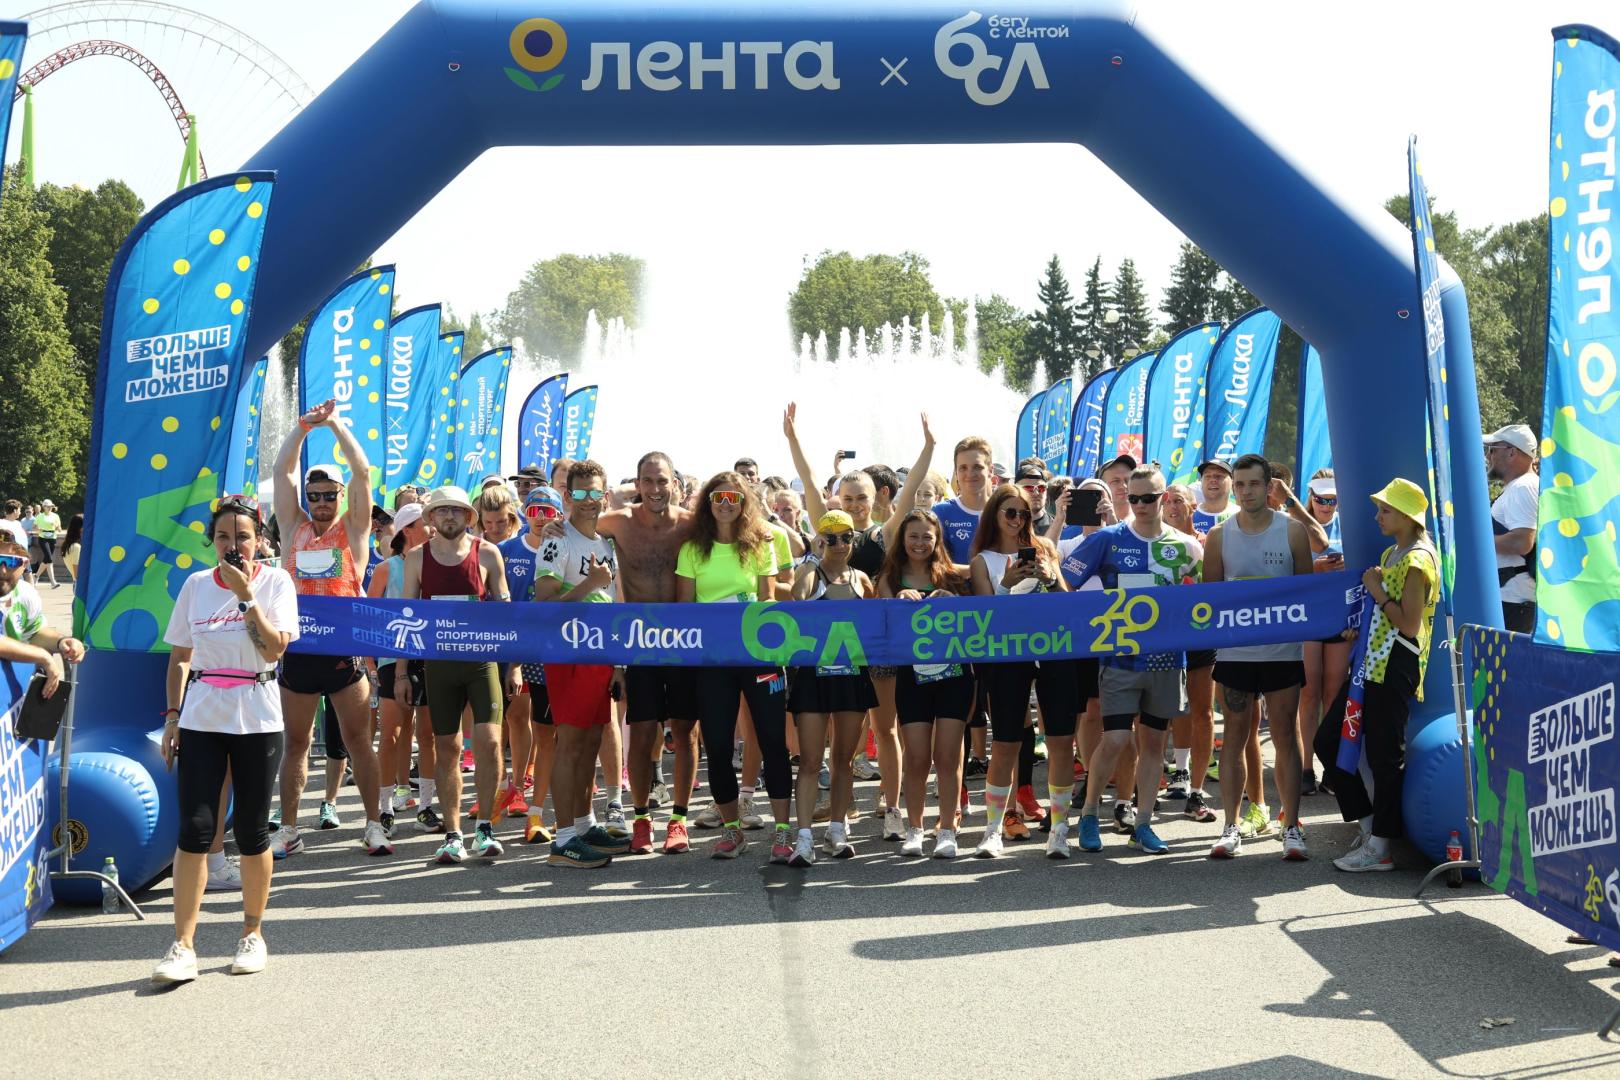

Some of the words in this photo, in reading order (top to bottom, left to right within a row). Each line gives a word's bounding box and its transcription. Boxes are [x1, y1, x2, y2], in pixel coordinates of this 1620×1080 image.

[988, 15, 1029, 29] бегу
[1006, 25, 1069, 38] лентой
[582, 41, 840, 91] лента
[129, 327, 229, 360] БОЛЬШЕ
[155, 352, 201, 375] ЧЕМ
[1225, 334, 1255, 408] Ласка
[128, 368, 227, 400] МОЖЕШЬ
[1173, 352, 1193, 438] лента
[436, 619, 456, 628] МЫ
[911, 604, 993, 640] бегу
[1216, 604, 1308, 628] лента
[436, 631, 518, 641] СПОРТИВНЫЙ
[436, 643, 500, 652] ПЕТЕРБУРГ
[561, 618, 604, 649] Фа
[624, 619, 703, 649] Ласка
[945, 625, 1072, 659] лентой
[1530, 688, 1612, 760] БОЛЬШЕ
[0, 761, 22, 819] ЕМ
[1549, 750, 1588, 799] ЧЕМ
[0, 793, 44, 871] ЖЕШЬ
[1530, 794, 1613, 855] МОЖЕШЬ
